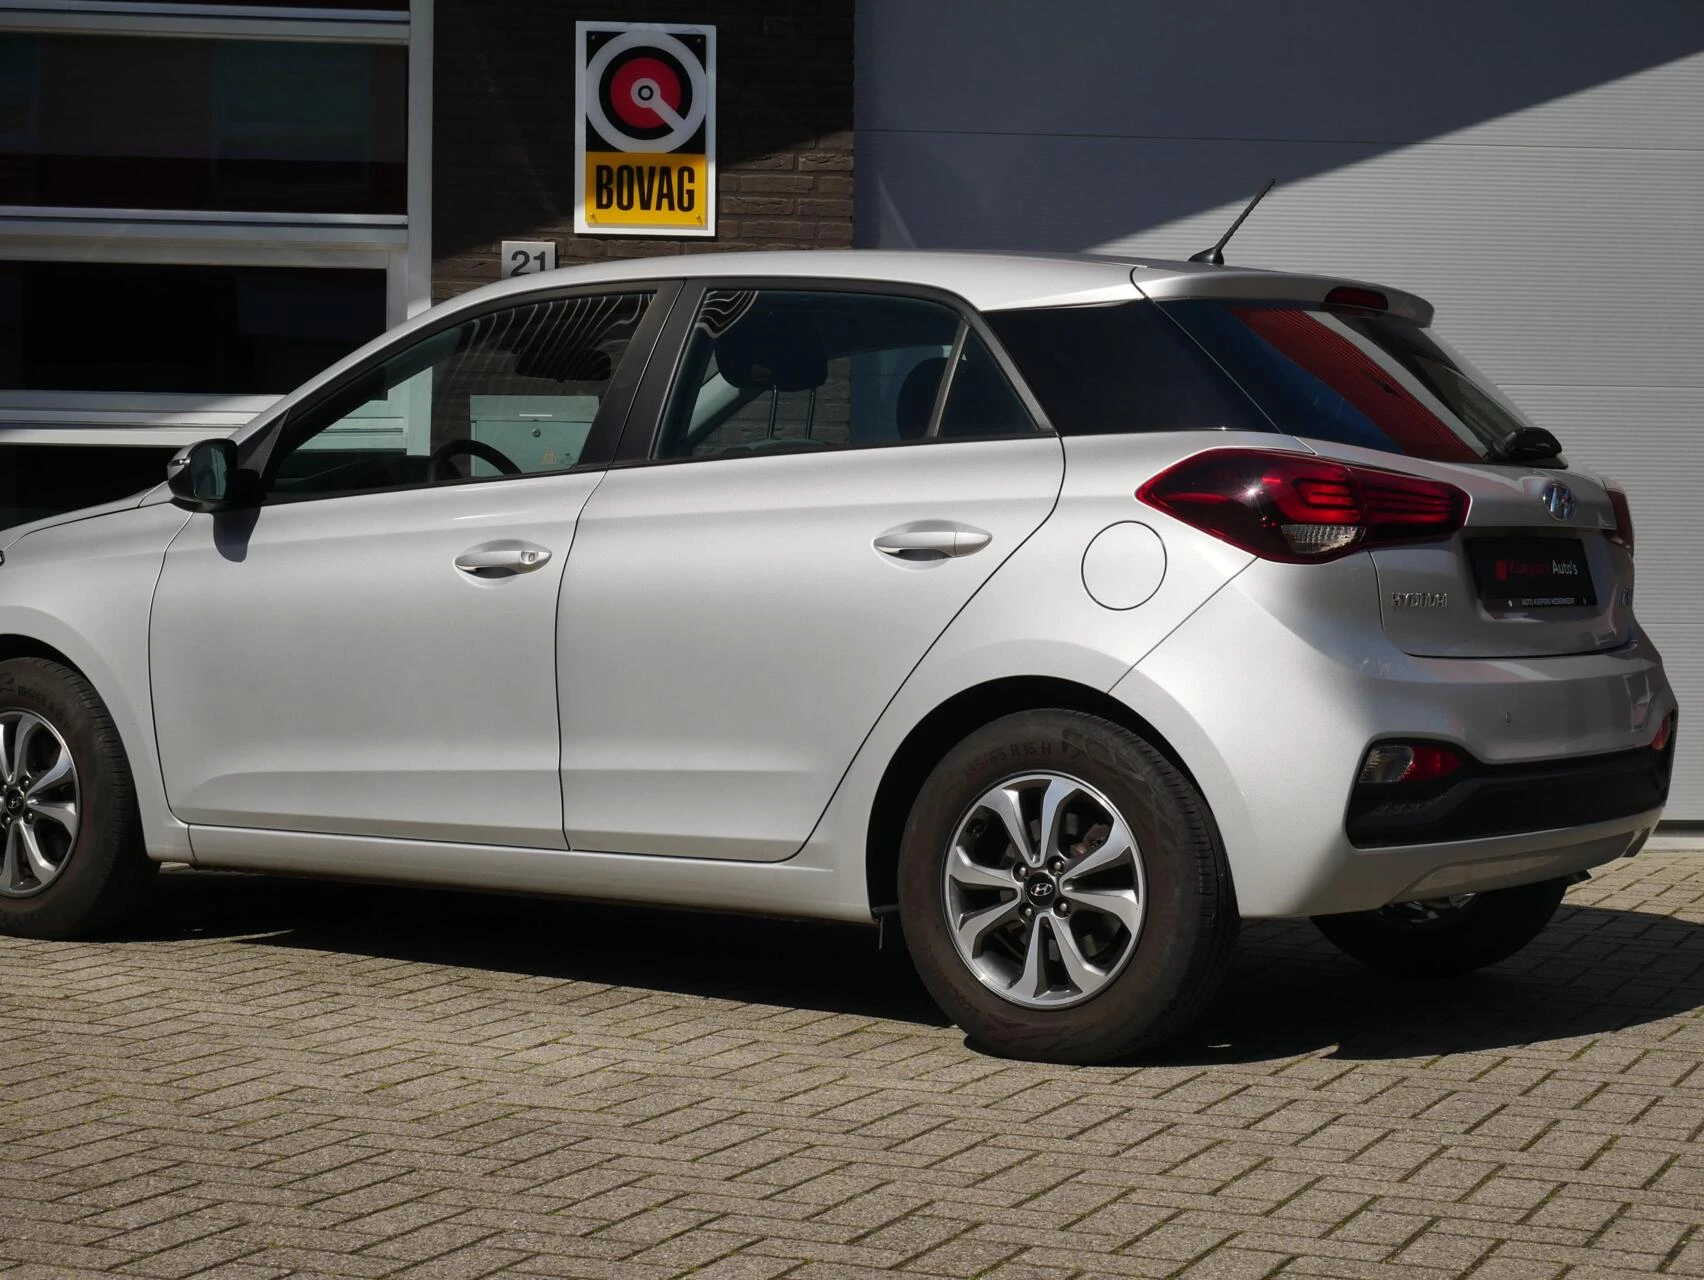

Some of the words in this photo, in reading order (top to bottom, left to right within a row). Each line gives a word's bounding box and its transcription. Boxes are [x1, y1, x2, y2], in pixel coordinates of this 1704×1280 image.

[595, 164, 696, 213] BOVAG
[511, 250, 546, 277] 21
[1552, 559, 1579, 576] Auto's
